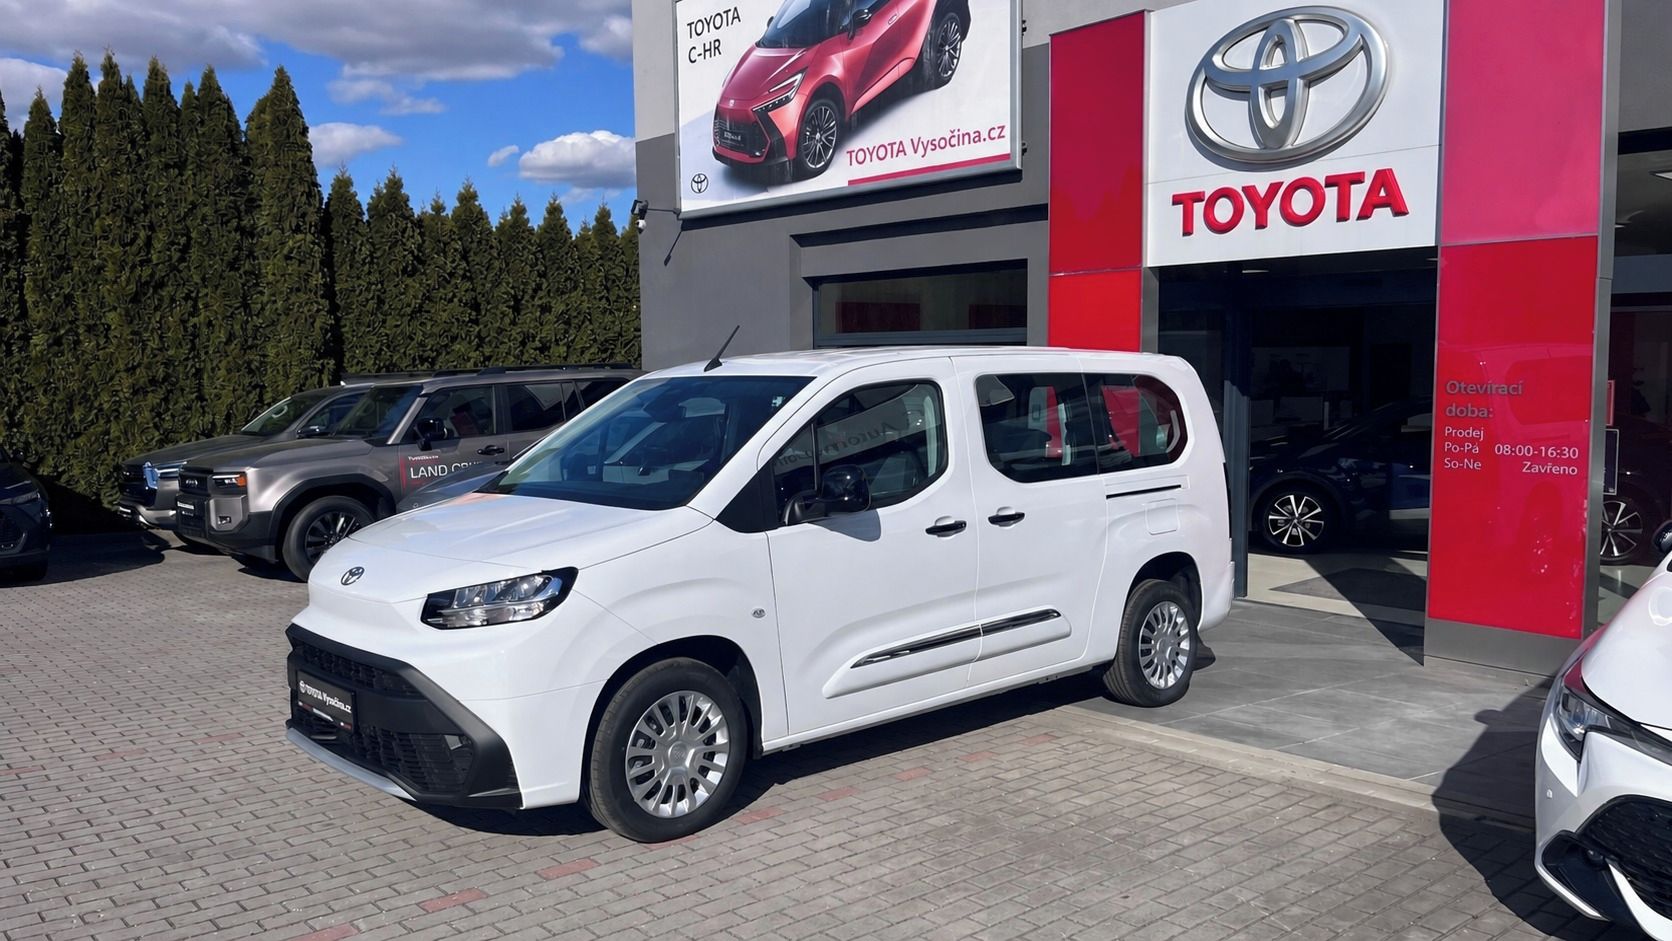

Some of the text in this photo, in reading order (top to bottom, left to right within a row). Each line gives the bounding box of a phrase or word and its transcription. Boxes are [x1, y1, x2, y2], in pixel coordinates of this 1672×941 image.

[687, 6, 741, 39] TOYOTA
[688, 38, 722, 64] C-HR
[846, 124, 1006, 167] TOYOTA Vysočina.cz
[1172, 168, 1409, 237] TOYOTA
[1446, 380, 1524, 395] Otevírací
[1445, 403, 1494, 418] doba:
[1444, 426, 1484, 441] Prodej
[1444, 441, 1579, 459] Po-Pá 08:00-16:30
[410, 464, 448, 479] LAND
[1444, 457, 1578, 476] So-Ne Zavřeno
